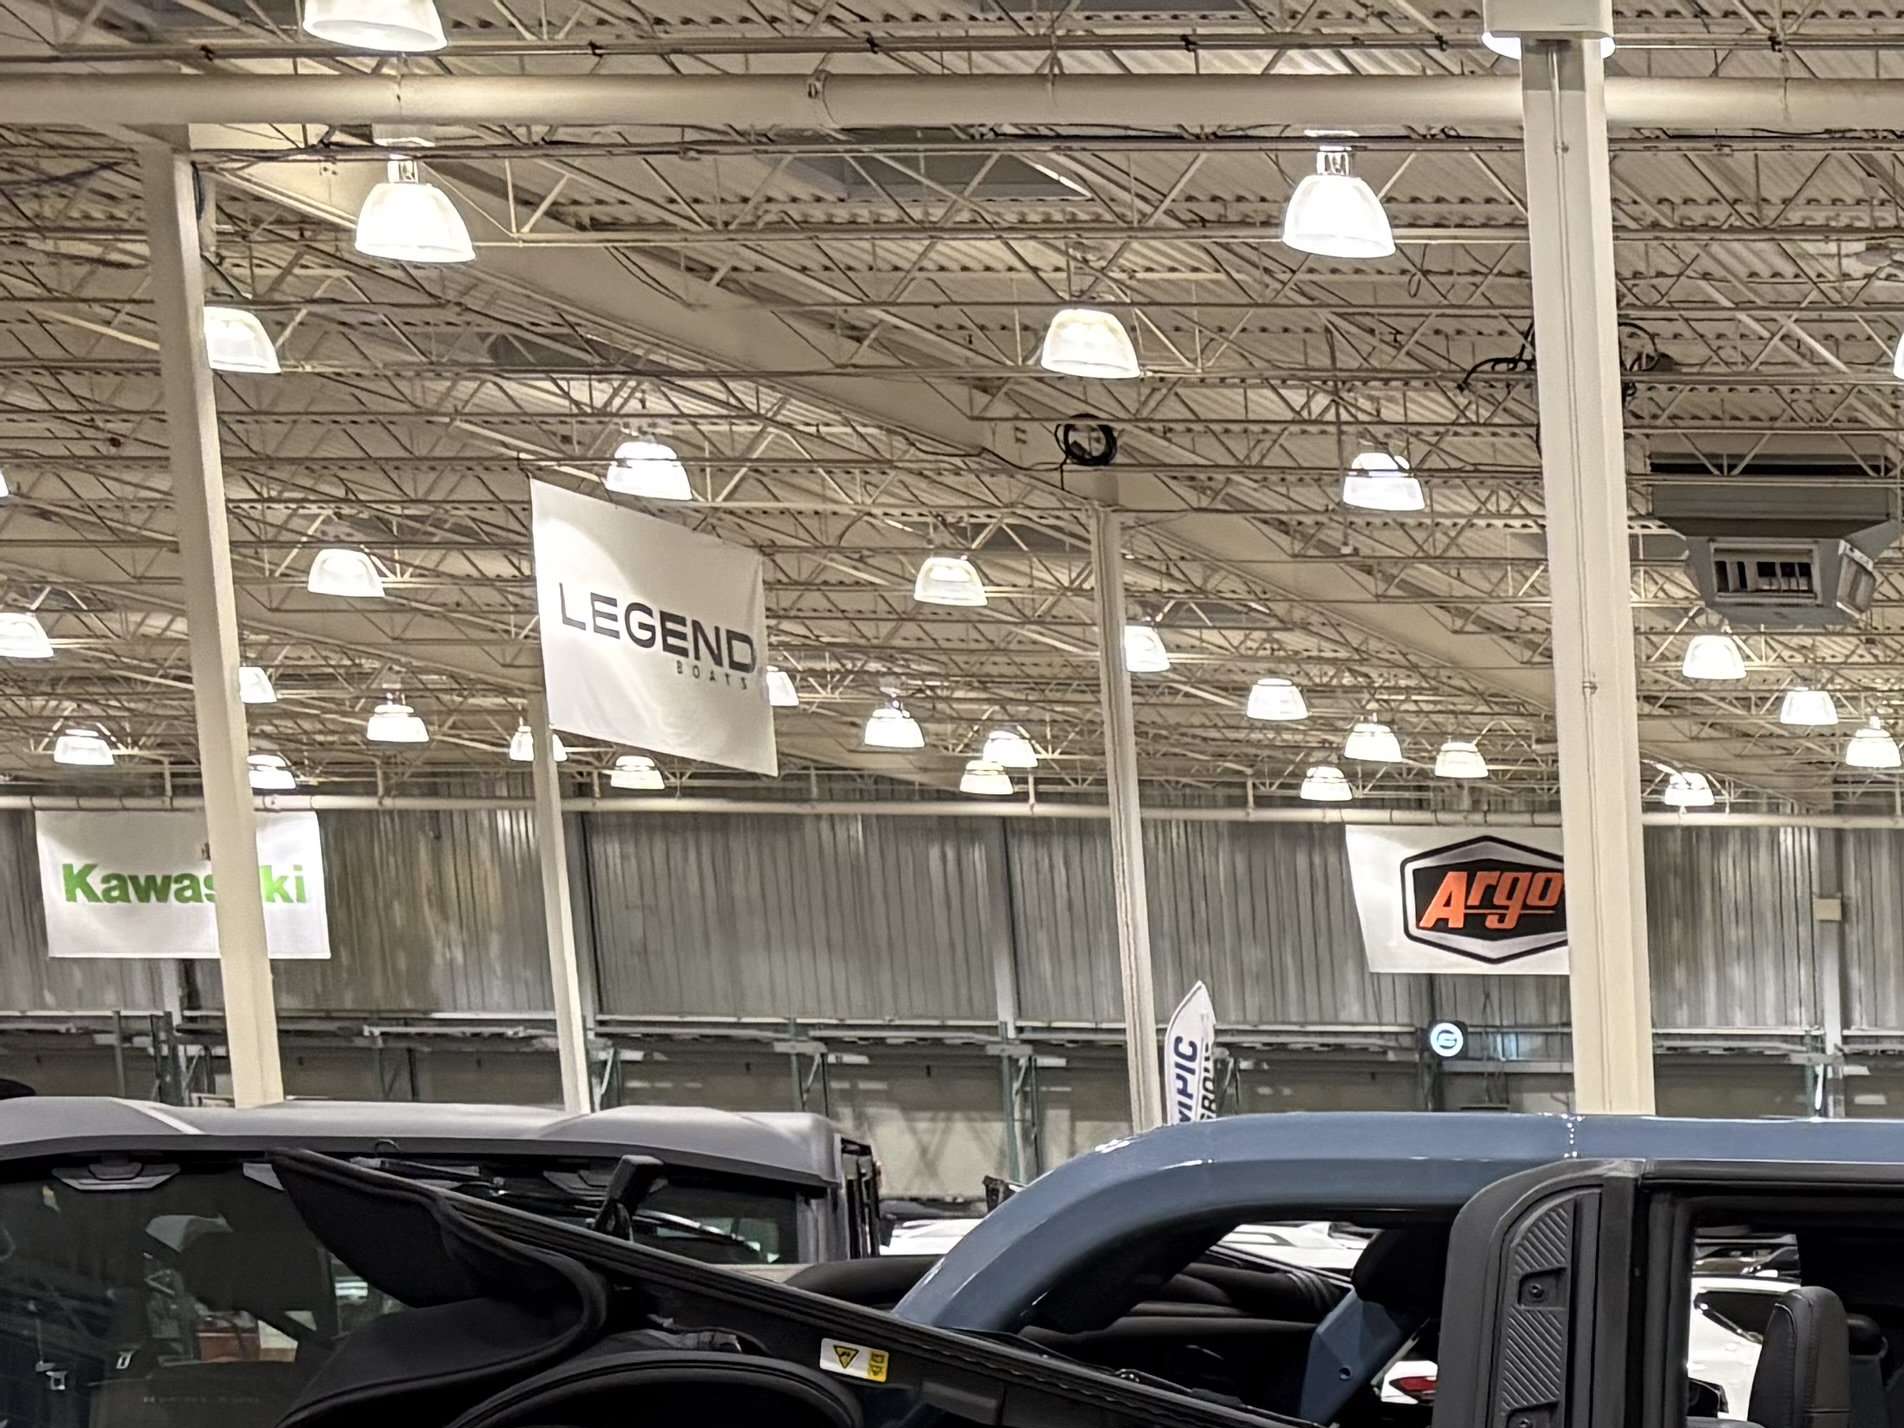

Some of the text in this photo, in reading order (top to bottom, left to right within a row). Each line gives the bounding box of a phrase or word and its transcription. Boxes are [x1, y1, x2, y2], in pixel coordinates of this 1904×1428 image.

[559, 582, 757, 673] LEGEND
[676, 660, 748, 690] BOATS
[62, 863, 307, 904] Kawaki
[1419, 871, 1565, 929] Argo
